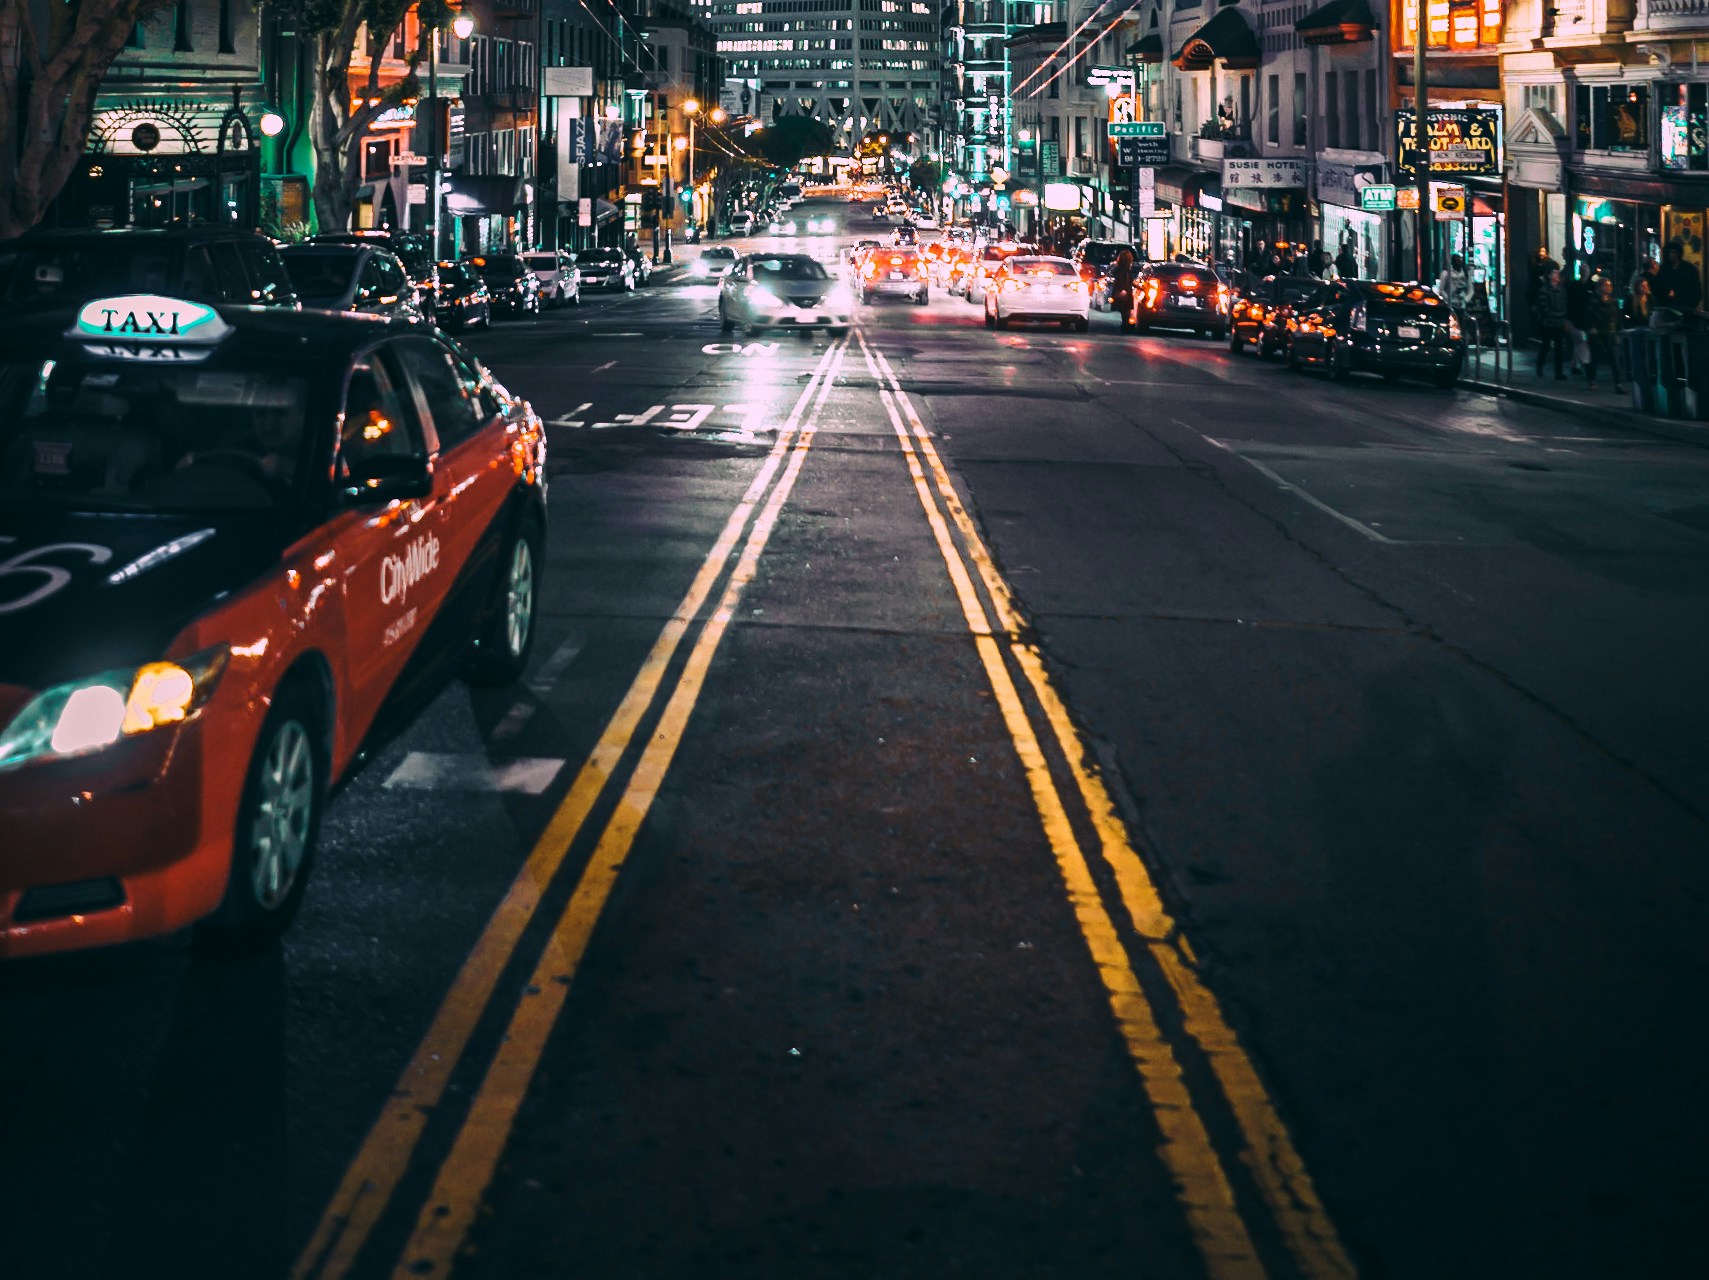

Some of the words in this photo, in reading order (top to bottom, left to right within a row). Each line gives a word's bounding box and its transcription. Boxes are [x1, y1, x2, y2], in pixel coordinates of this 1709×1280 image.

[1114, 125, 1159, 134] Pacific
[576, 116, 585, 163] SFJAZZ
[1402, 137, 1449, 150] TOT
[1229, 161, 1259, 169] SUSIE
[1267, 161, 1301, 169] HOTEL
[1364, 189, 1392, 201] ATM
[101, 309, 180, 335] TAXI
